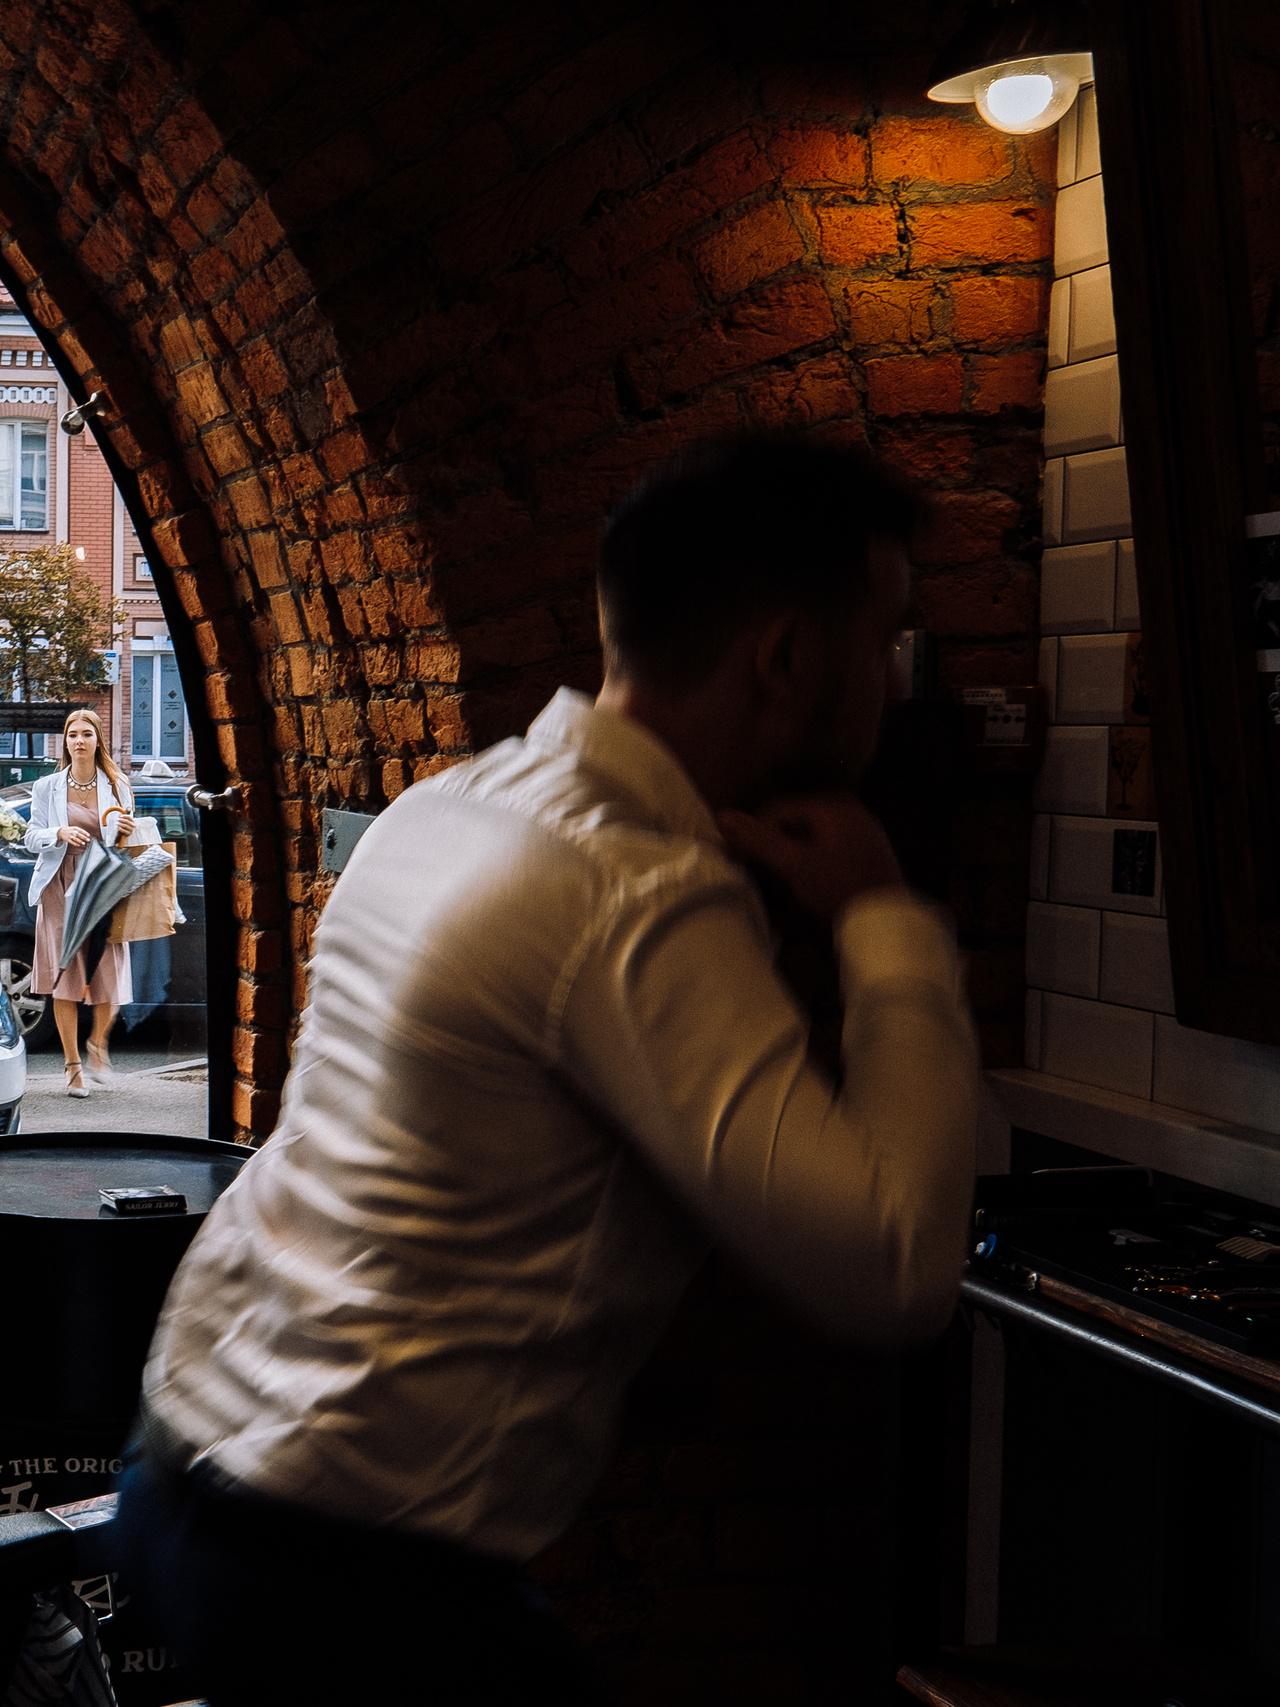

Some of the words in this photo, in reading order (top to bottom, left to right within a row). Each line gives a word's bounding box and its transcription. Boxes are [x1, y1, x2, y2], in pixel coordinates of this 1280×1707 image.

[9, 1458, 58, 1476] THE
[64, 1457, 123, 1475] ORIG
[121, 1646, 178, 1673] RU
